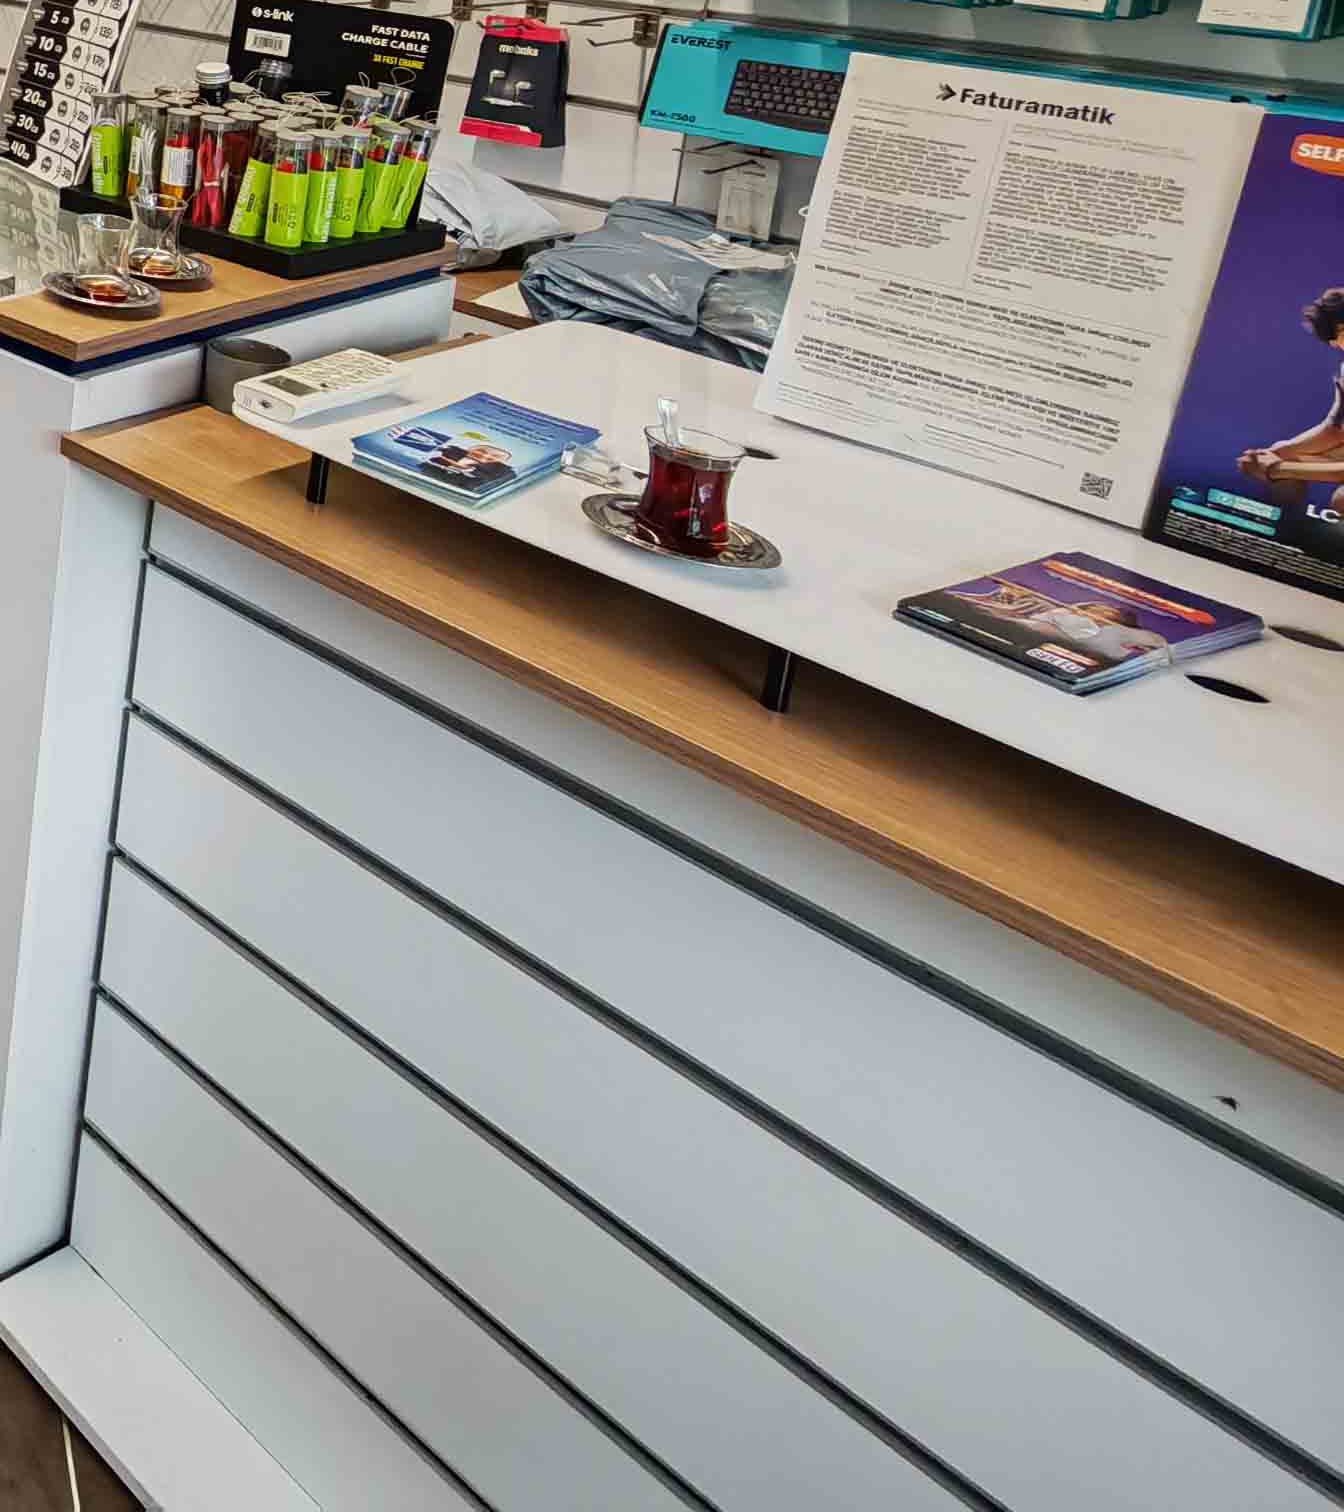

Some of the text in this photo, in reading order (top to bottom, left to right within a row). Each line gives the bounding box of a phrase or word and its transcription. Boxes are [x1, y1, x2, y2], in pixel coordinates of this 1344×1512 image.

[50, 10, 60, 25] 5
[263, 9, 294, 22] s-link
[371, 24, 430, 42] FAST DATA
[670, 33, 733, 50] EVEREST
[39, 36, 54, 52] 10
[341, 32, 429, 53] CHARGE CABLE
[33, 62, 48, 78] 15
[23, 89, 39, 106] 20
[960, 88, 1115, 126] Faturamatik
[17, 114, 32, 131] 30
[11, 141, 25, 158] 40
